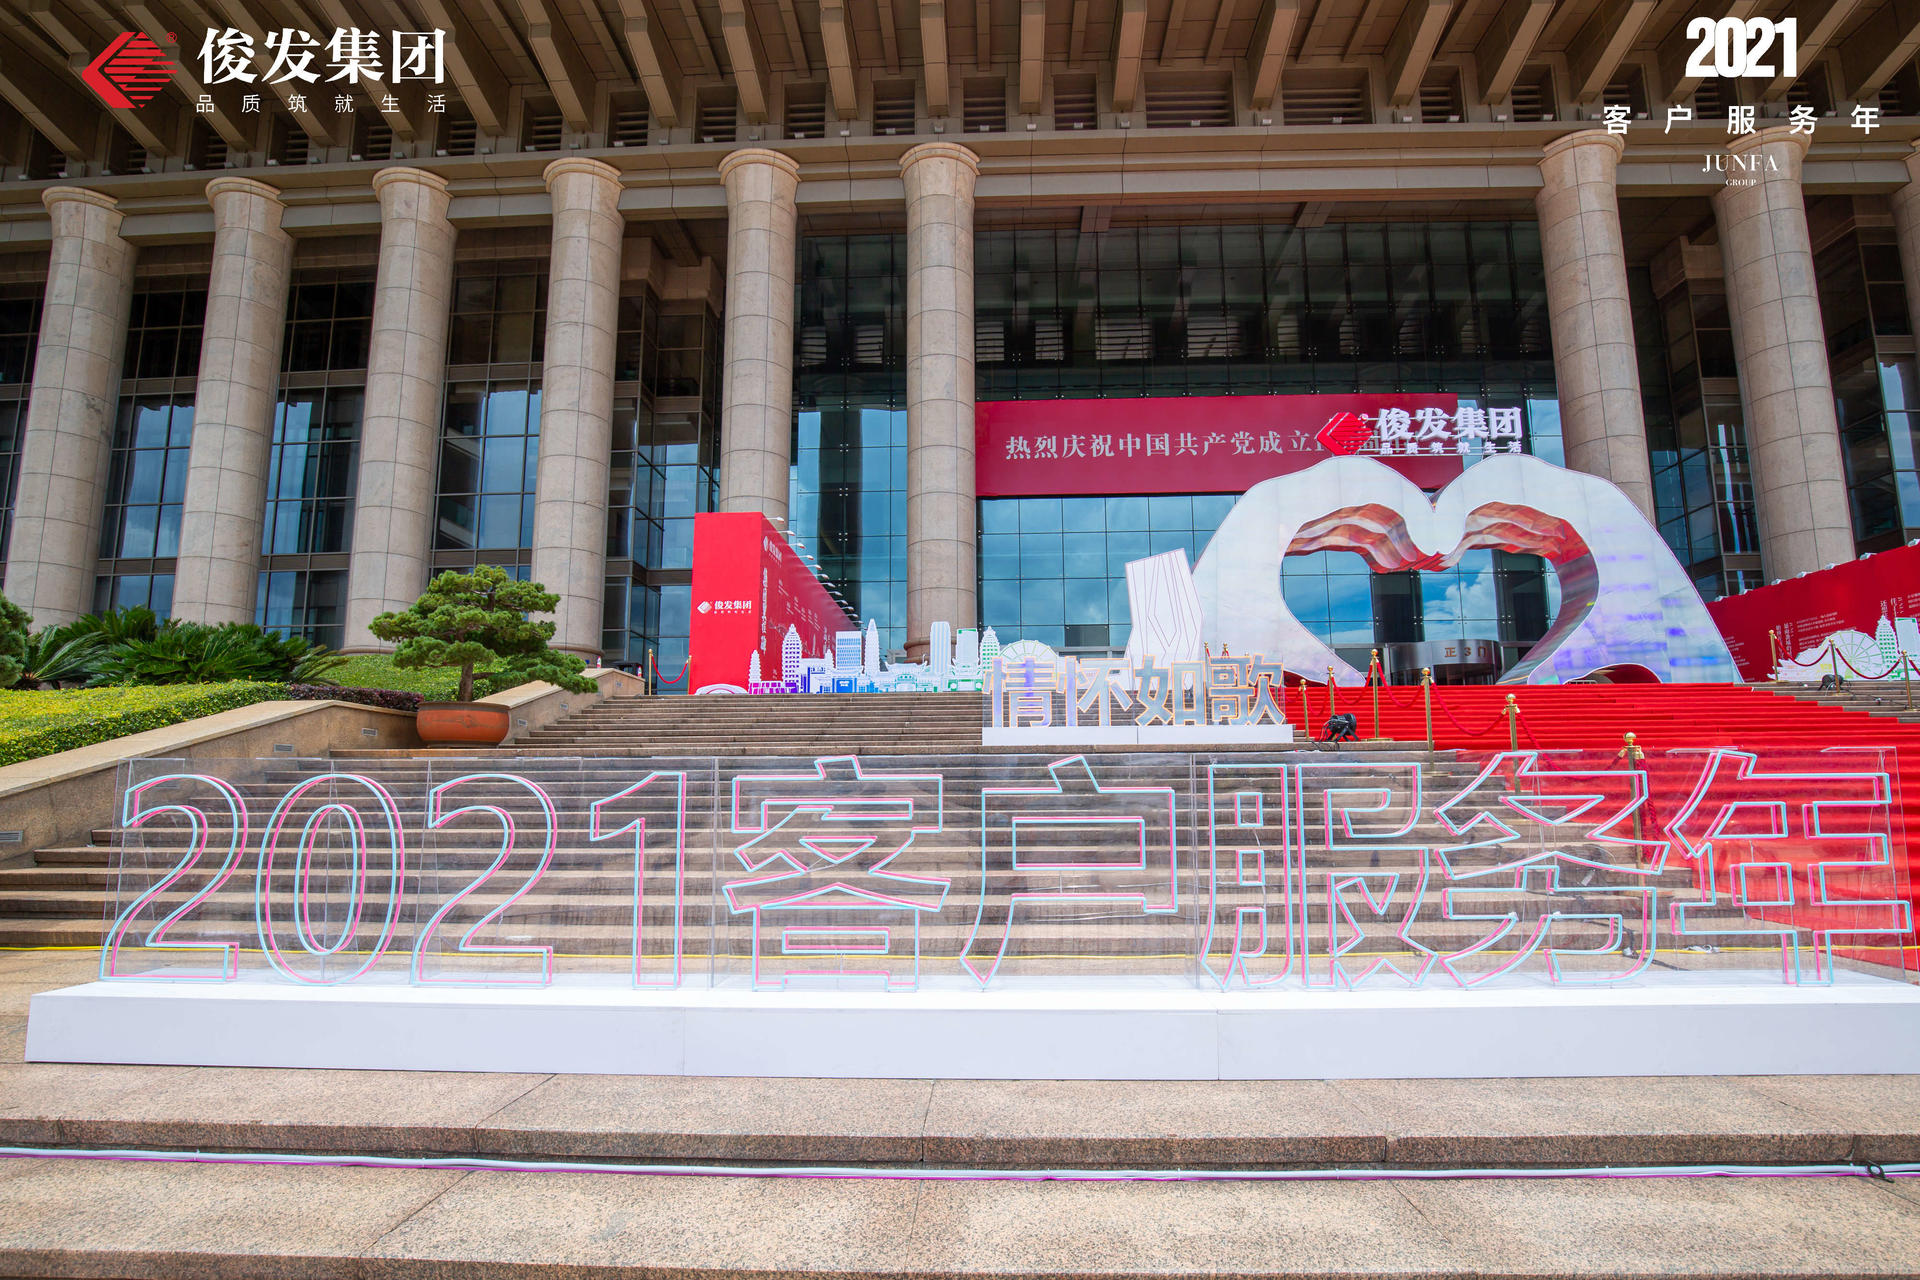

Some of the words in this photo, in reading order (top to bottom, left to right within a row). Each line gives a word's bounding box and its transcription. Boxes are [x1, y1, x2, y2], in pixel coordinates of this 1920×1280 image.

[1376, 407, 1523, 440] 俊发集团
[1380, 441, 1522, 456] 品质筑就生活
[714, 600, 752, 610] 俊发集团
[982, 653, 1286, 728] 情怀如歌
